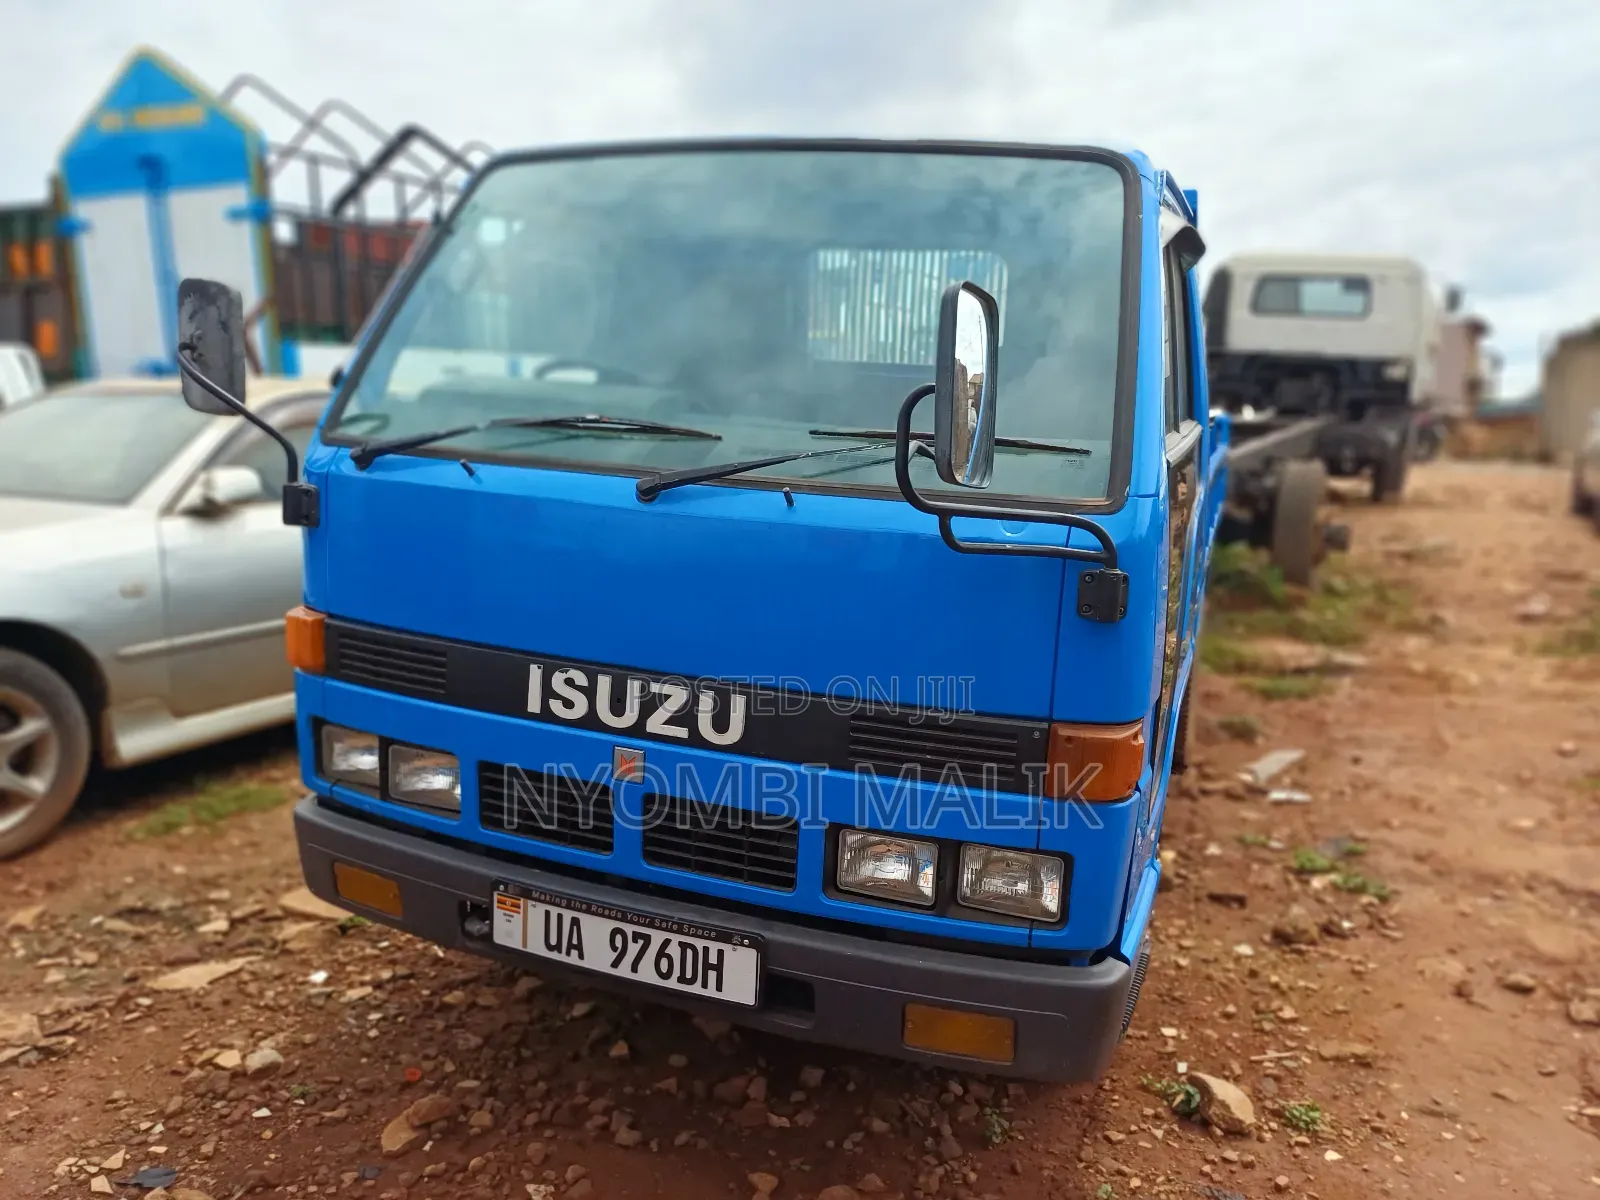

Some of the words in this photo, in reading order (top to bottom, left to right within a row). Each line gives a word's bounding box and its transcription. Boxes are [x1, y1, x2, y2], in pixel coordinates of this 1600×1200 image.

[526, 663, 746, 745] ISUZU
[531, 890, 567, 907] Making
[571, 900, 587, 910] the
[591, 904, 622, 919] Roads
[626, 912, 650, 925] Your
[654, 918, 678, 931] Safe
[682, 924, 717, 938] Space
[544, 909, 585, 961] UA
[609, 926, 725, 993] 976DH
